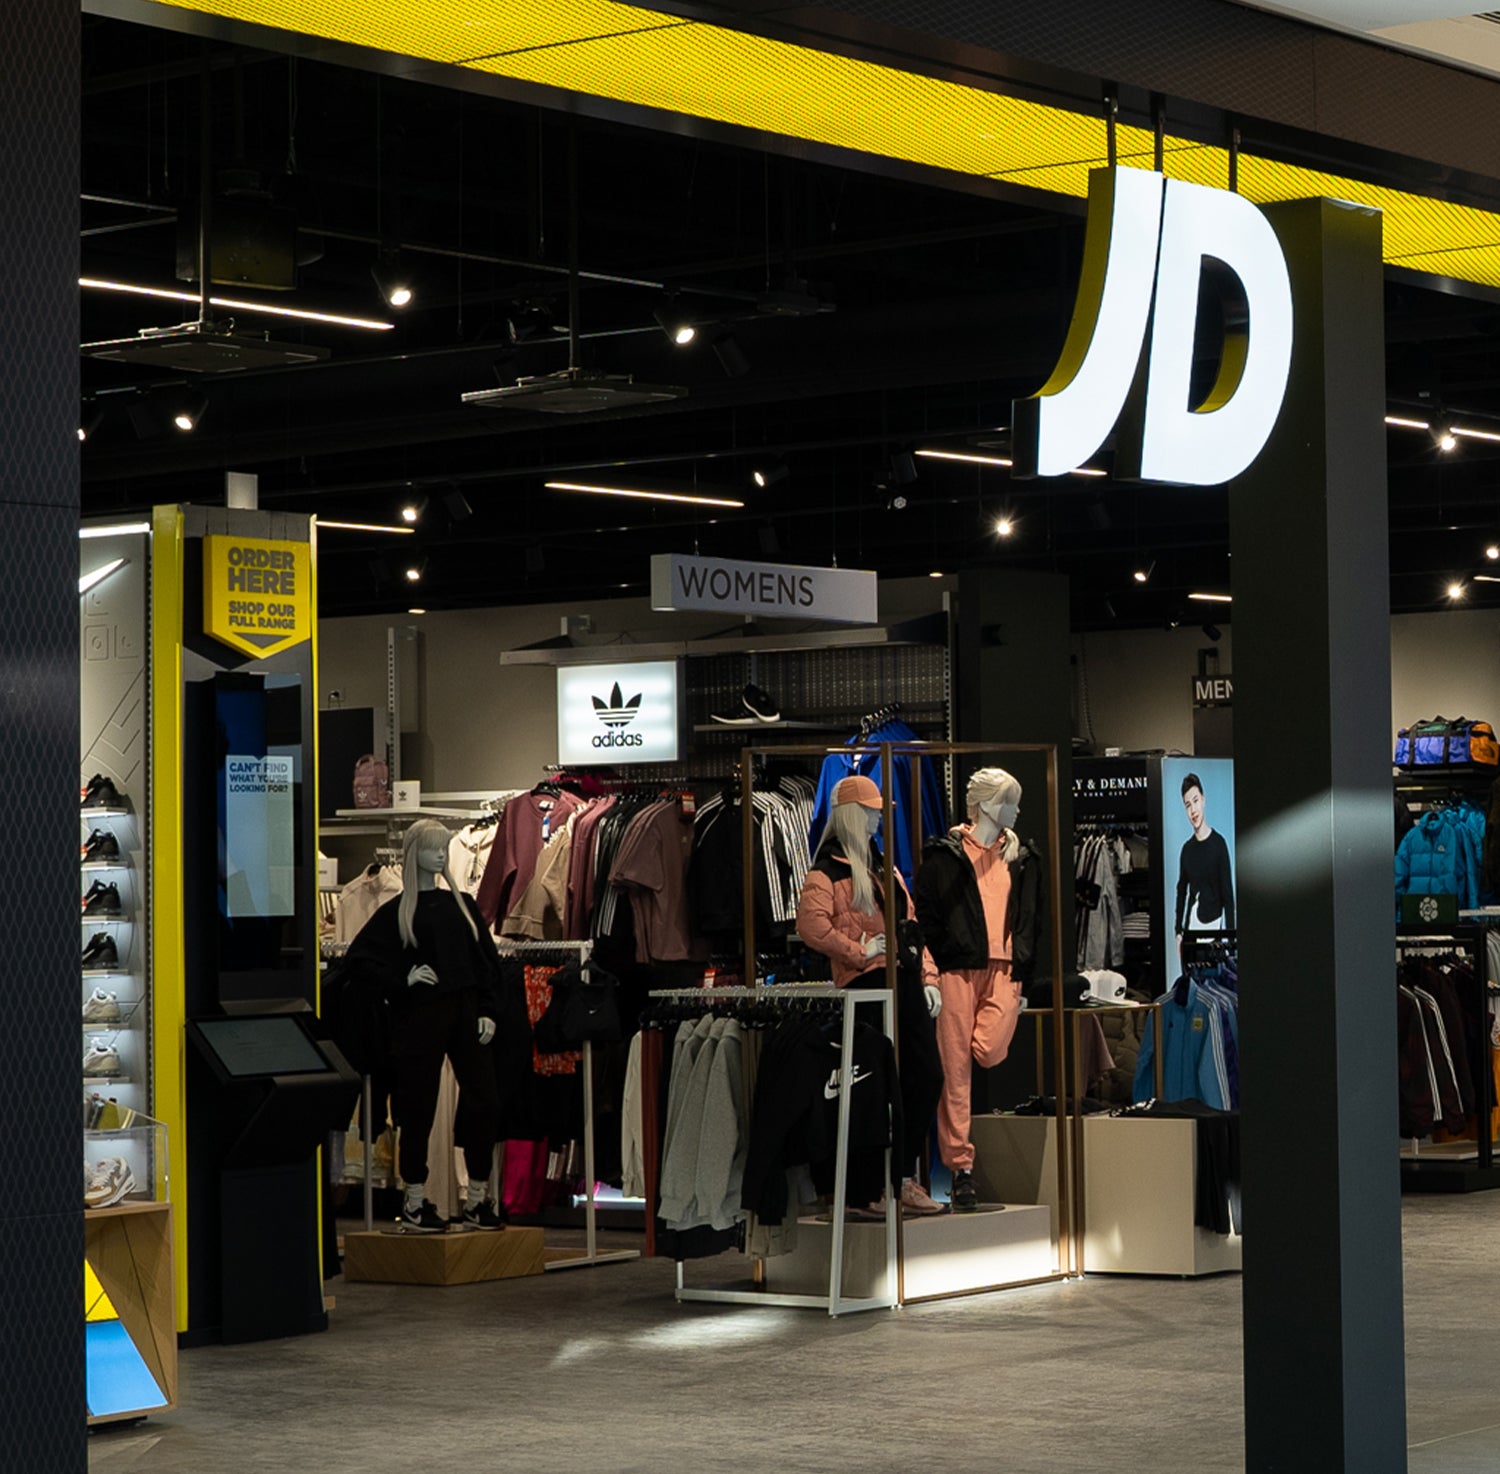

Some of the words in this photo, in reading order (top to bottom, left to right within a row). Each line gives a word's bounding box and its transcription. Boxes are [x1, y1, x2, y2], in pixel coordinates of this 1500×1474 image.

[1037, 164, 1294, 486] JD
[228, 547, 295, 570] ORDER
[228, 567, 295, 596] HERE
[678, 565, 815, 607] WOMENS
[228, 600, 264, 615] SHOP
[267, 603, 295, 617] OUR
[228, 615, 256, 627] FULL
[258, 618, 295, 630] RANGE
[591, 730, 643, 748] adidas
[229, 762, 261, 773] CAN'T
[264, 763, 288, 773] FIND
[229, 774, 255, 783] WHAT
[229, 785, 266, 793] LOOKING
[267, 785, 288, 793] FOR?
